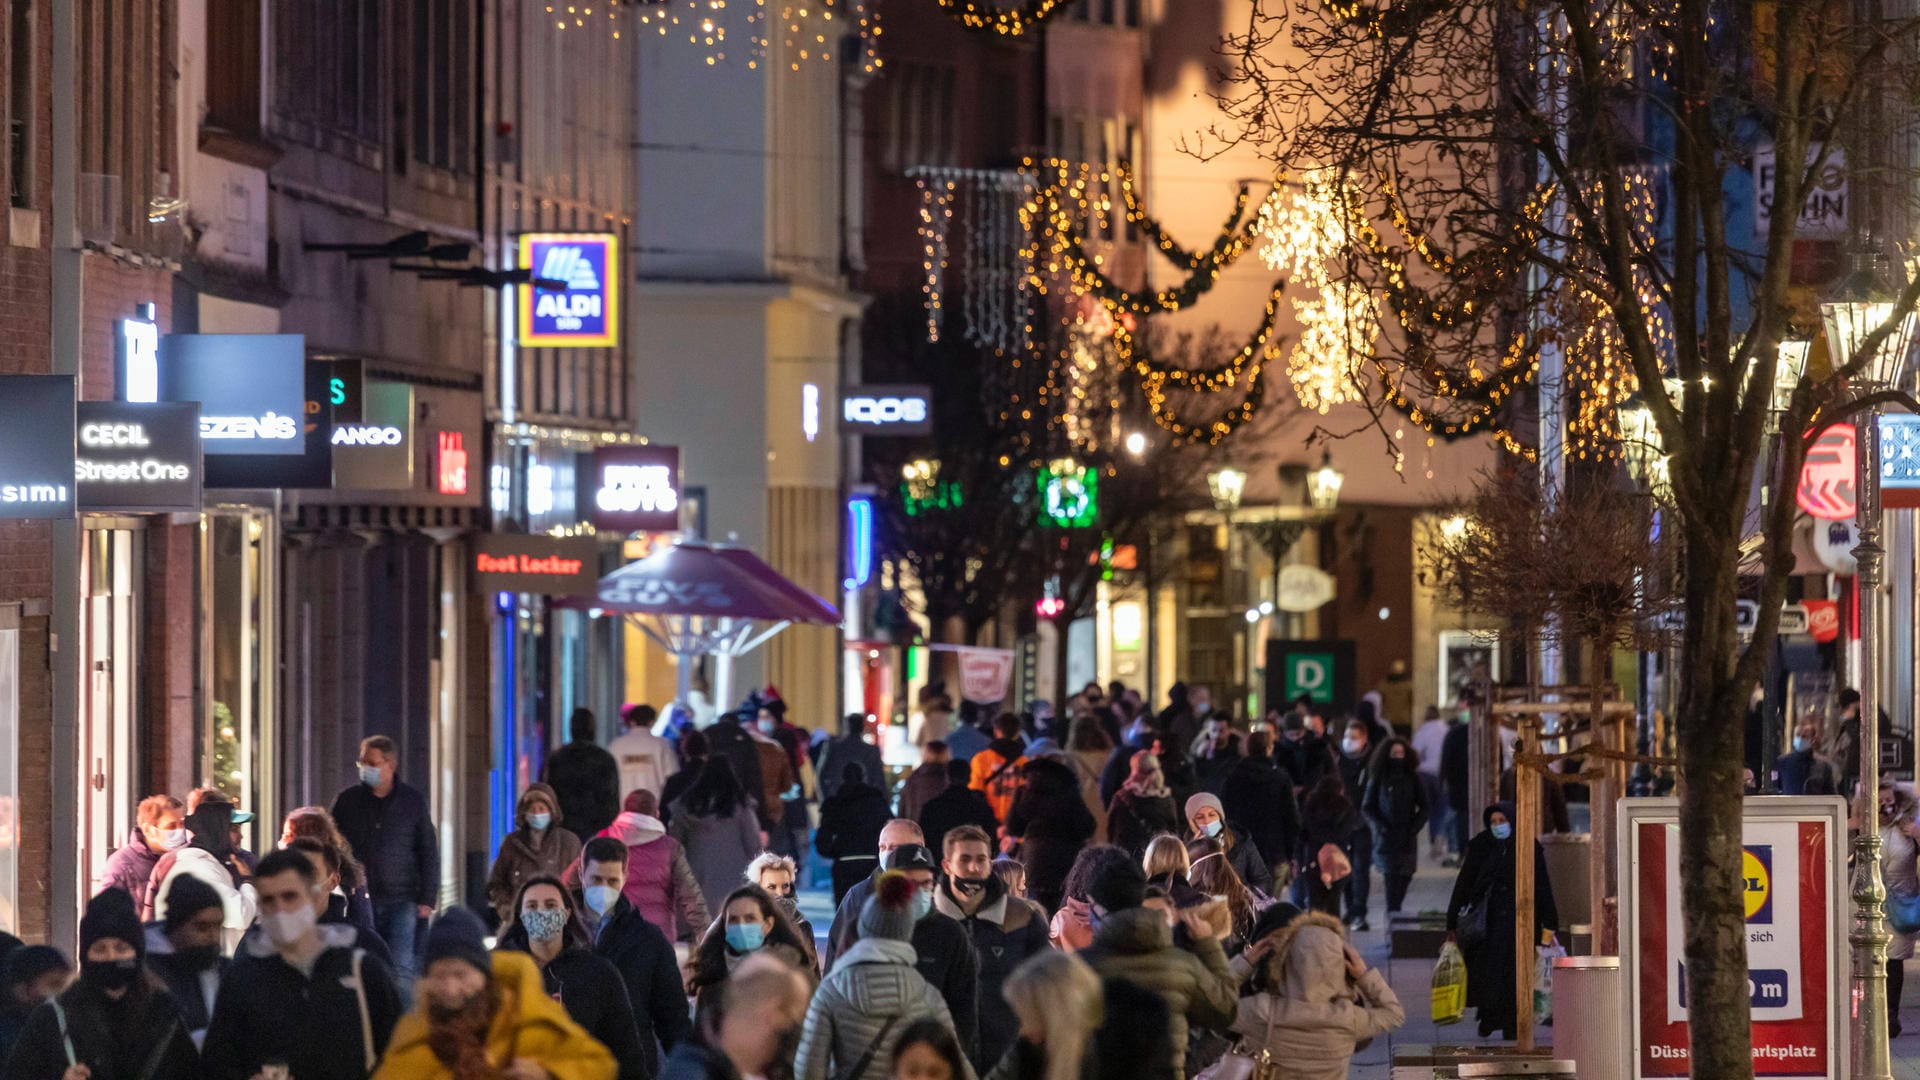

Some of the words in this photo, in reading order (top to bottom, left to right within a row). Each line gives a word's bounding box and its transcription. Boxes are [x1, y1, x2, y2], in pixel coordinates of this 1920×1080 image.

[1760, 194, 1843, 218] SHN
[536, 293, 602, 317] ALDI
[844, 398, 926, 424] IQOS
[82, 424, 149, 445] CECIL
[331, 427, 402, 444] ANGO
[75, 460, 140, 480] Street
[141, 460, 190, 480] One
[477, 553, 518, 573] Foot
[519, 554, 582, 574] Locker
[1295, 659, 1326, 689] D
[1750, 931, 1774, 942] sich
[1650, 1045, 1689, 1058] Düss
[1751, 1044, 1817, 1061] arlsplatz
